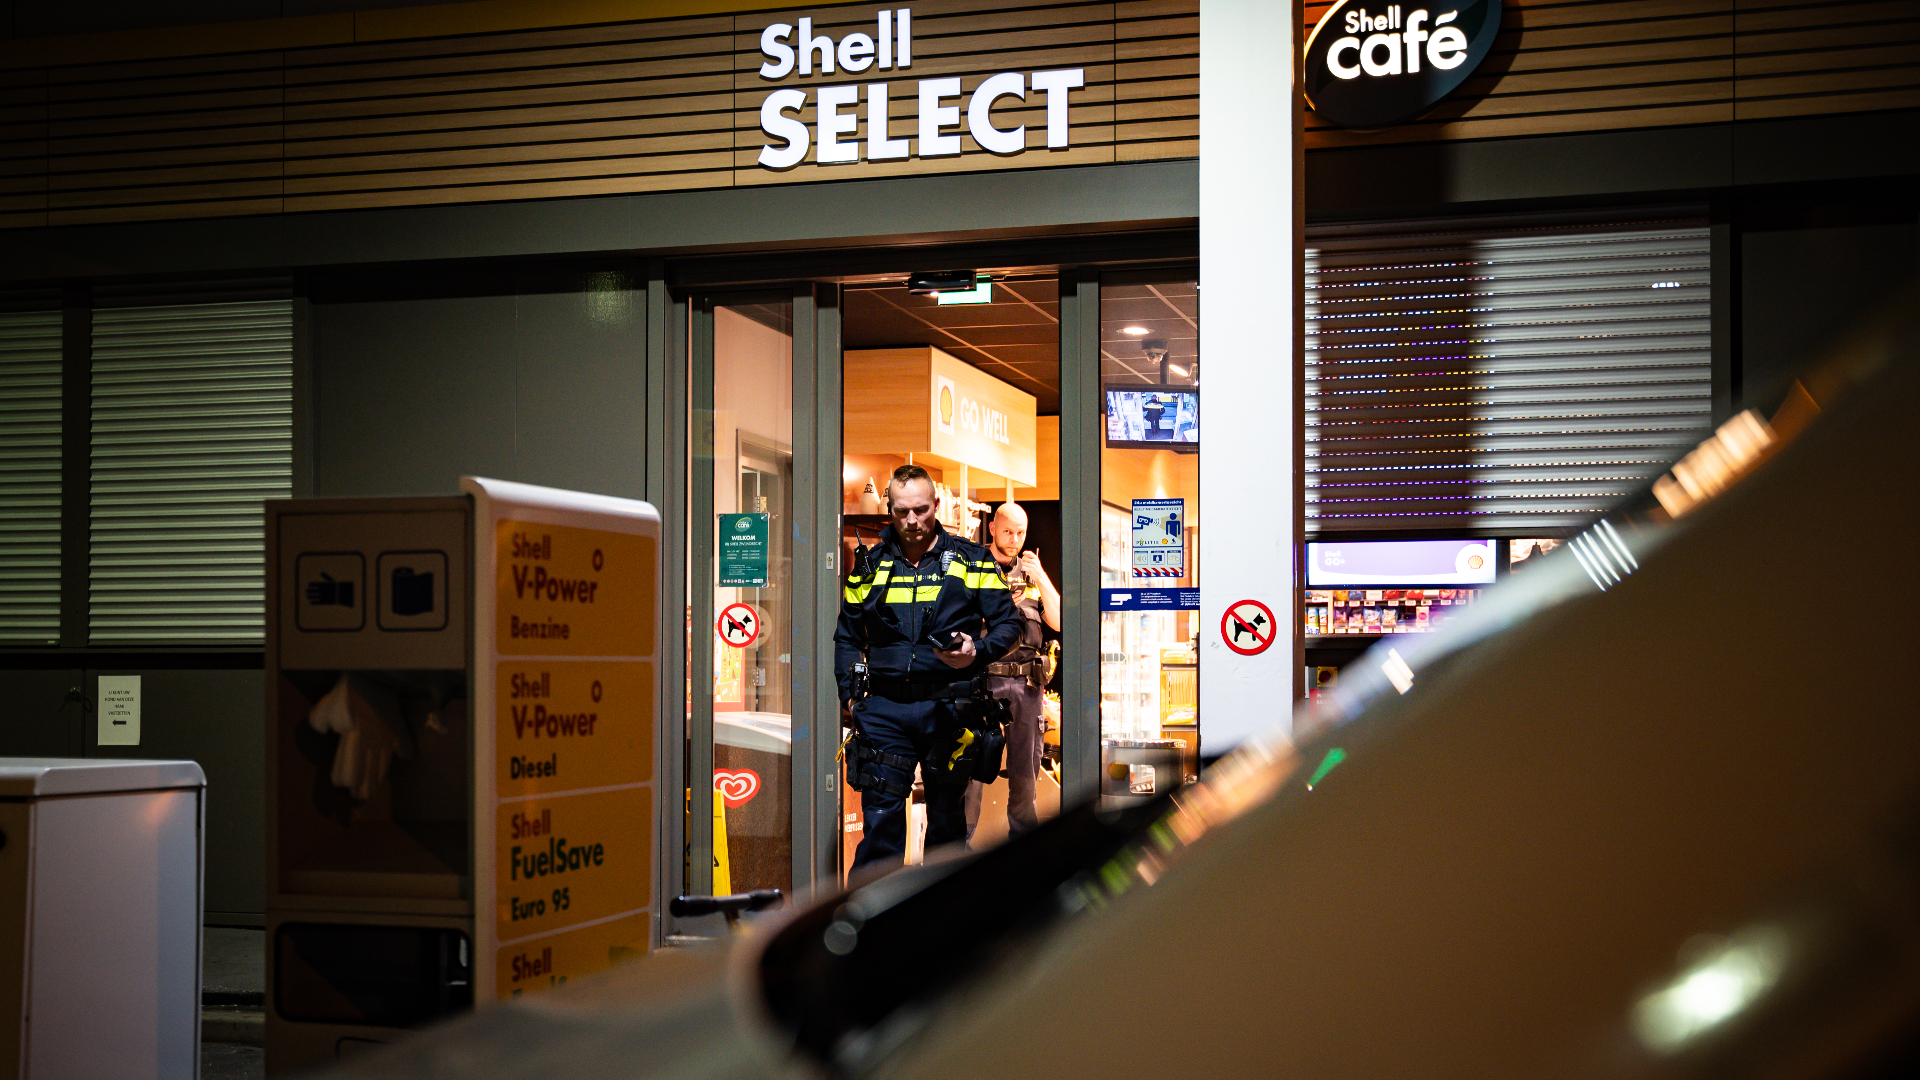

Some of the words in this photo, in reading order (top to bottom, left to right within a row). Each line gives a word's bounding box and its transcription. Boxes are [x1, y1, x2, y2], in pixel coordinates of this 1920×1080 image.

[1345, 5, 1401, 34] Shell
[759, 8, 912, 80] Shell
[1326, 10, 1468, 80] café
[757, 68, 1086, 169] SELECT
[960, 396, 979, 433] GO
[982, 405, 1010, 445] WELL
[511, 533, 551, 560] Shell
[510, 615, 570, 640] Benzine
[510, 672, 551, 699] Shell
[510, 752, 557, 780] Diesel
[511, 809, 551, 840] Shell
[510, 837, 604, 881] FuelSave
[511, 897, 546, 921] Euro
[552, 887, 571, 913] 95
[511, 946, 553, 983] Shell
